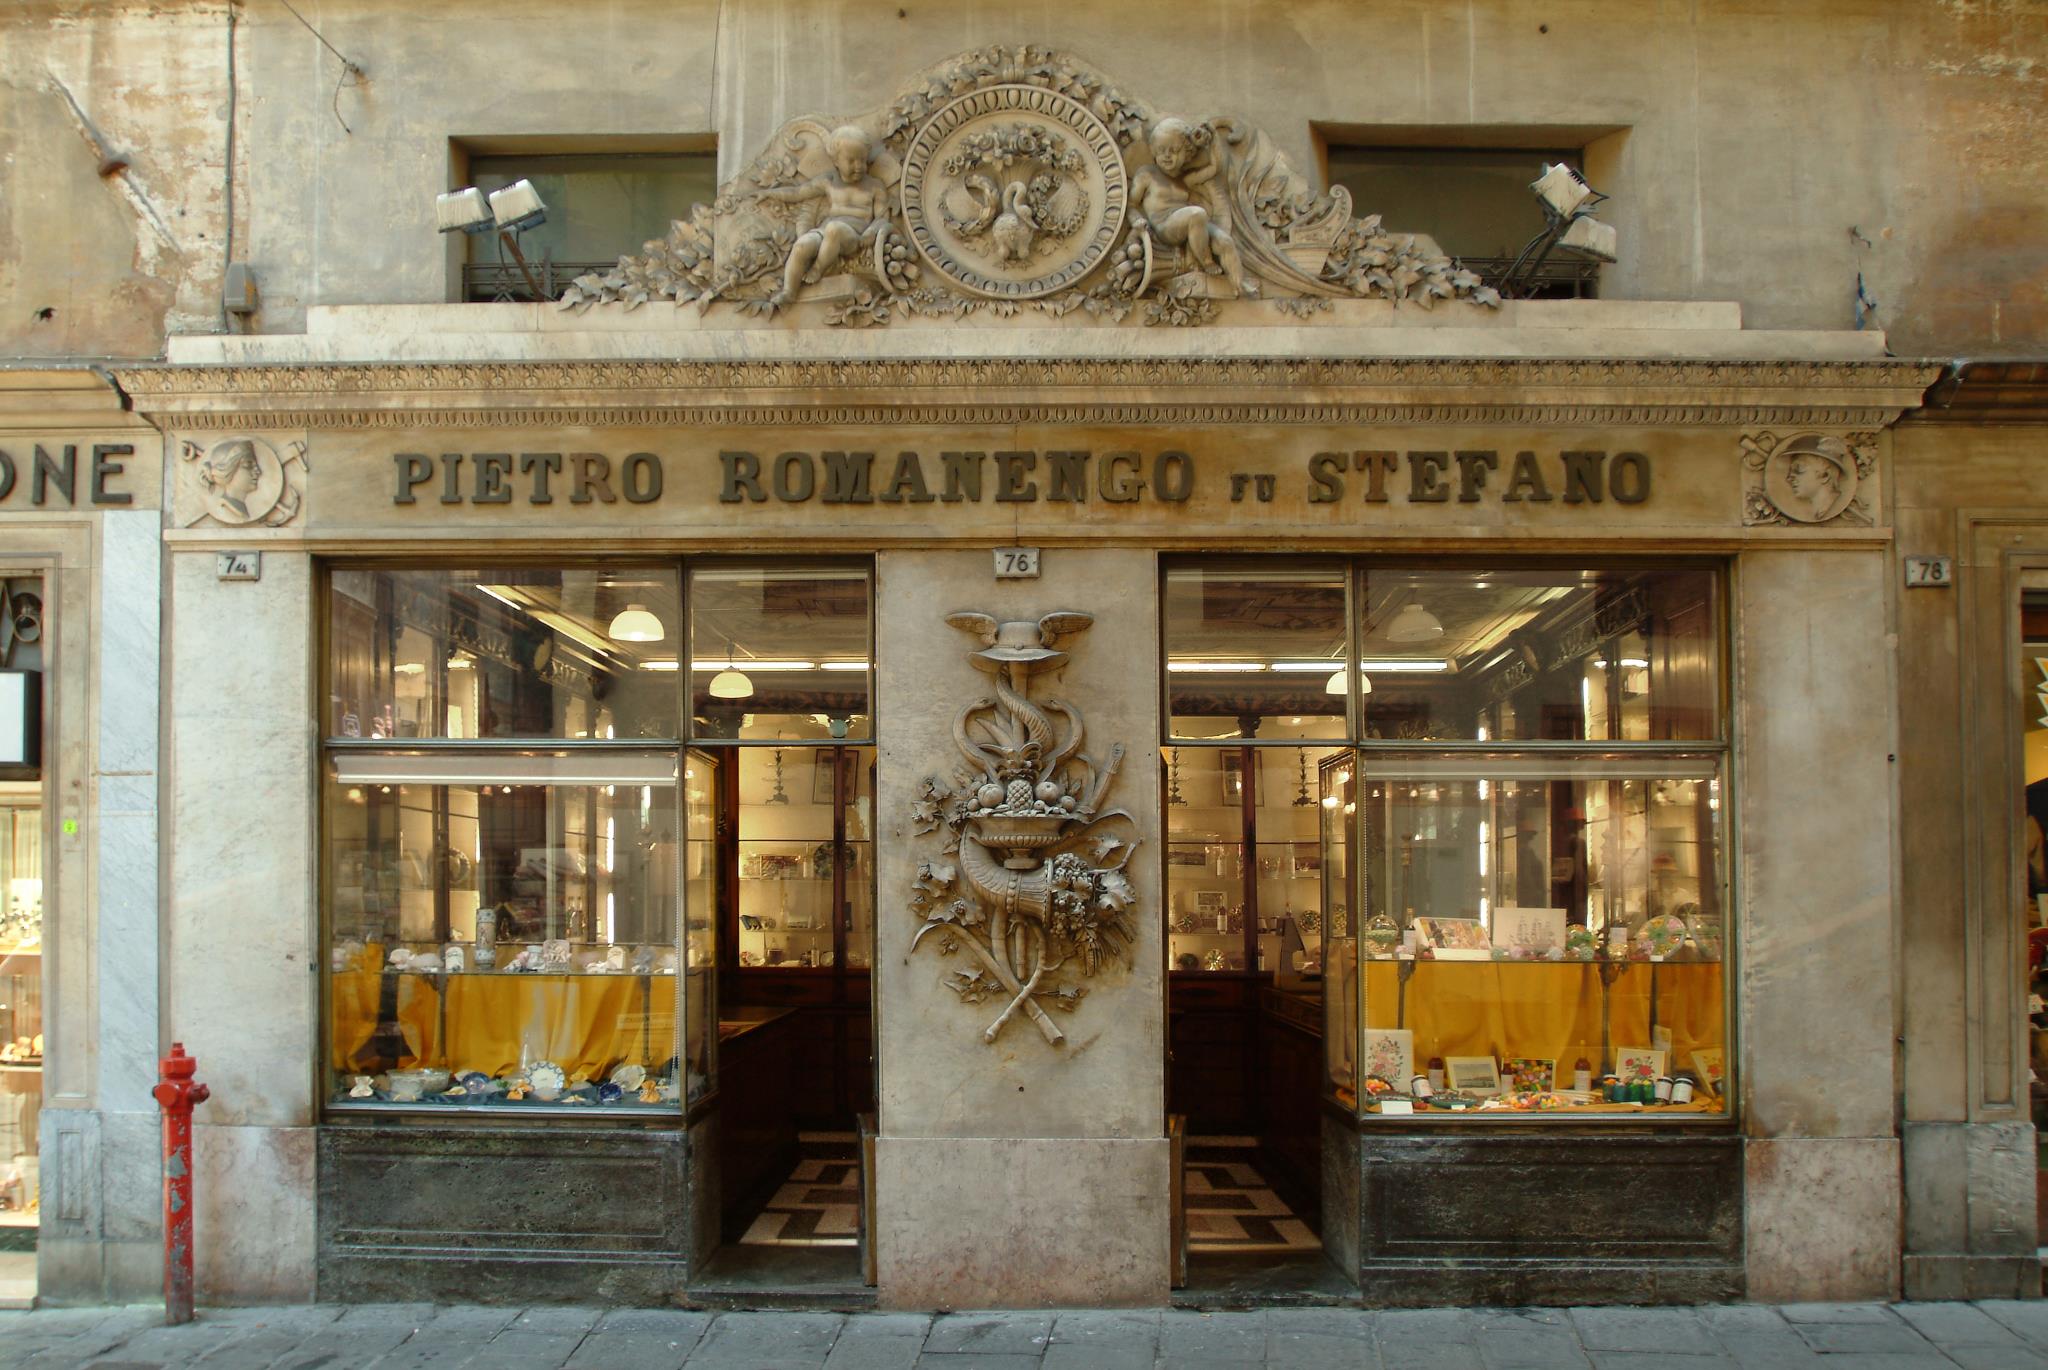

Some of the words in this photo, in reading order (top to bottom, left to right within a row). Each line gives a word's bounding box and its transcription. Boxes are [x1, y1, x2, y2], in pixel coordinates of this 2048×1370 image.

[0, 444, 134, 505] NE
[393, 452, 664, 505] PIETRO
[719, 450, 1195, 504] ROMANENGO
[1230, 473, 1276, 502] FU
[1307, 450, 1651, 504] STEFANO
[226, 556, 247, 574] 74
[1004, 553, 1029, 572] 76
[1919, 561, 1943, 580] 78
